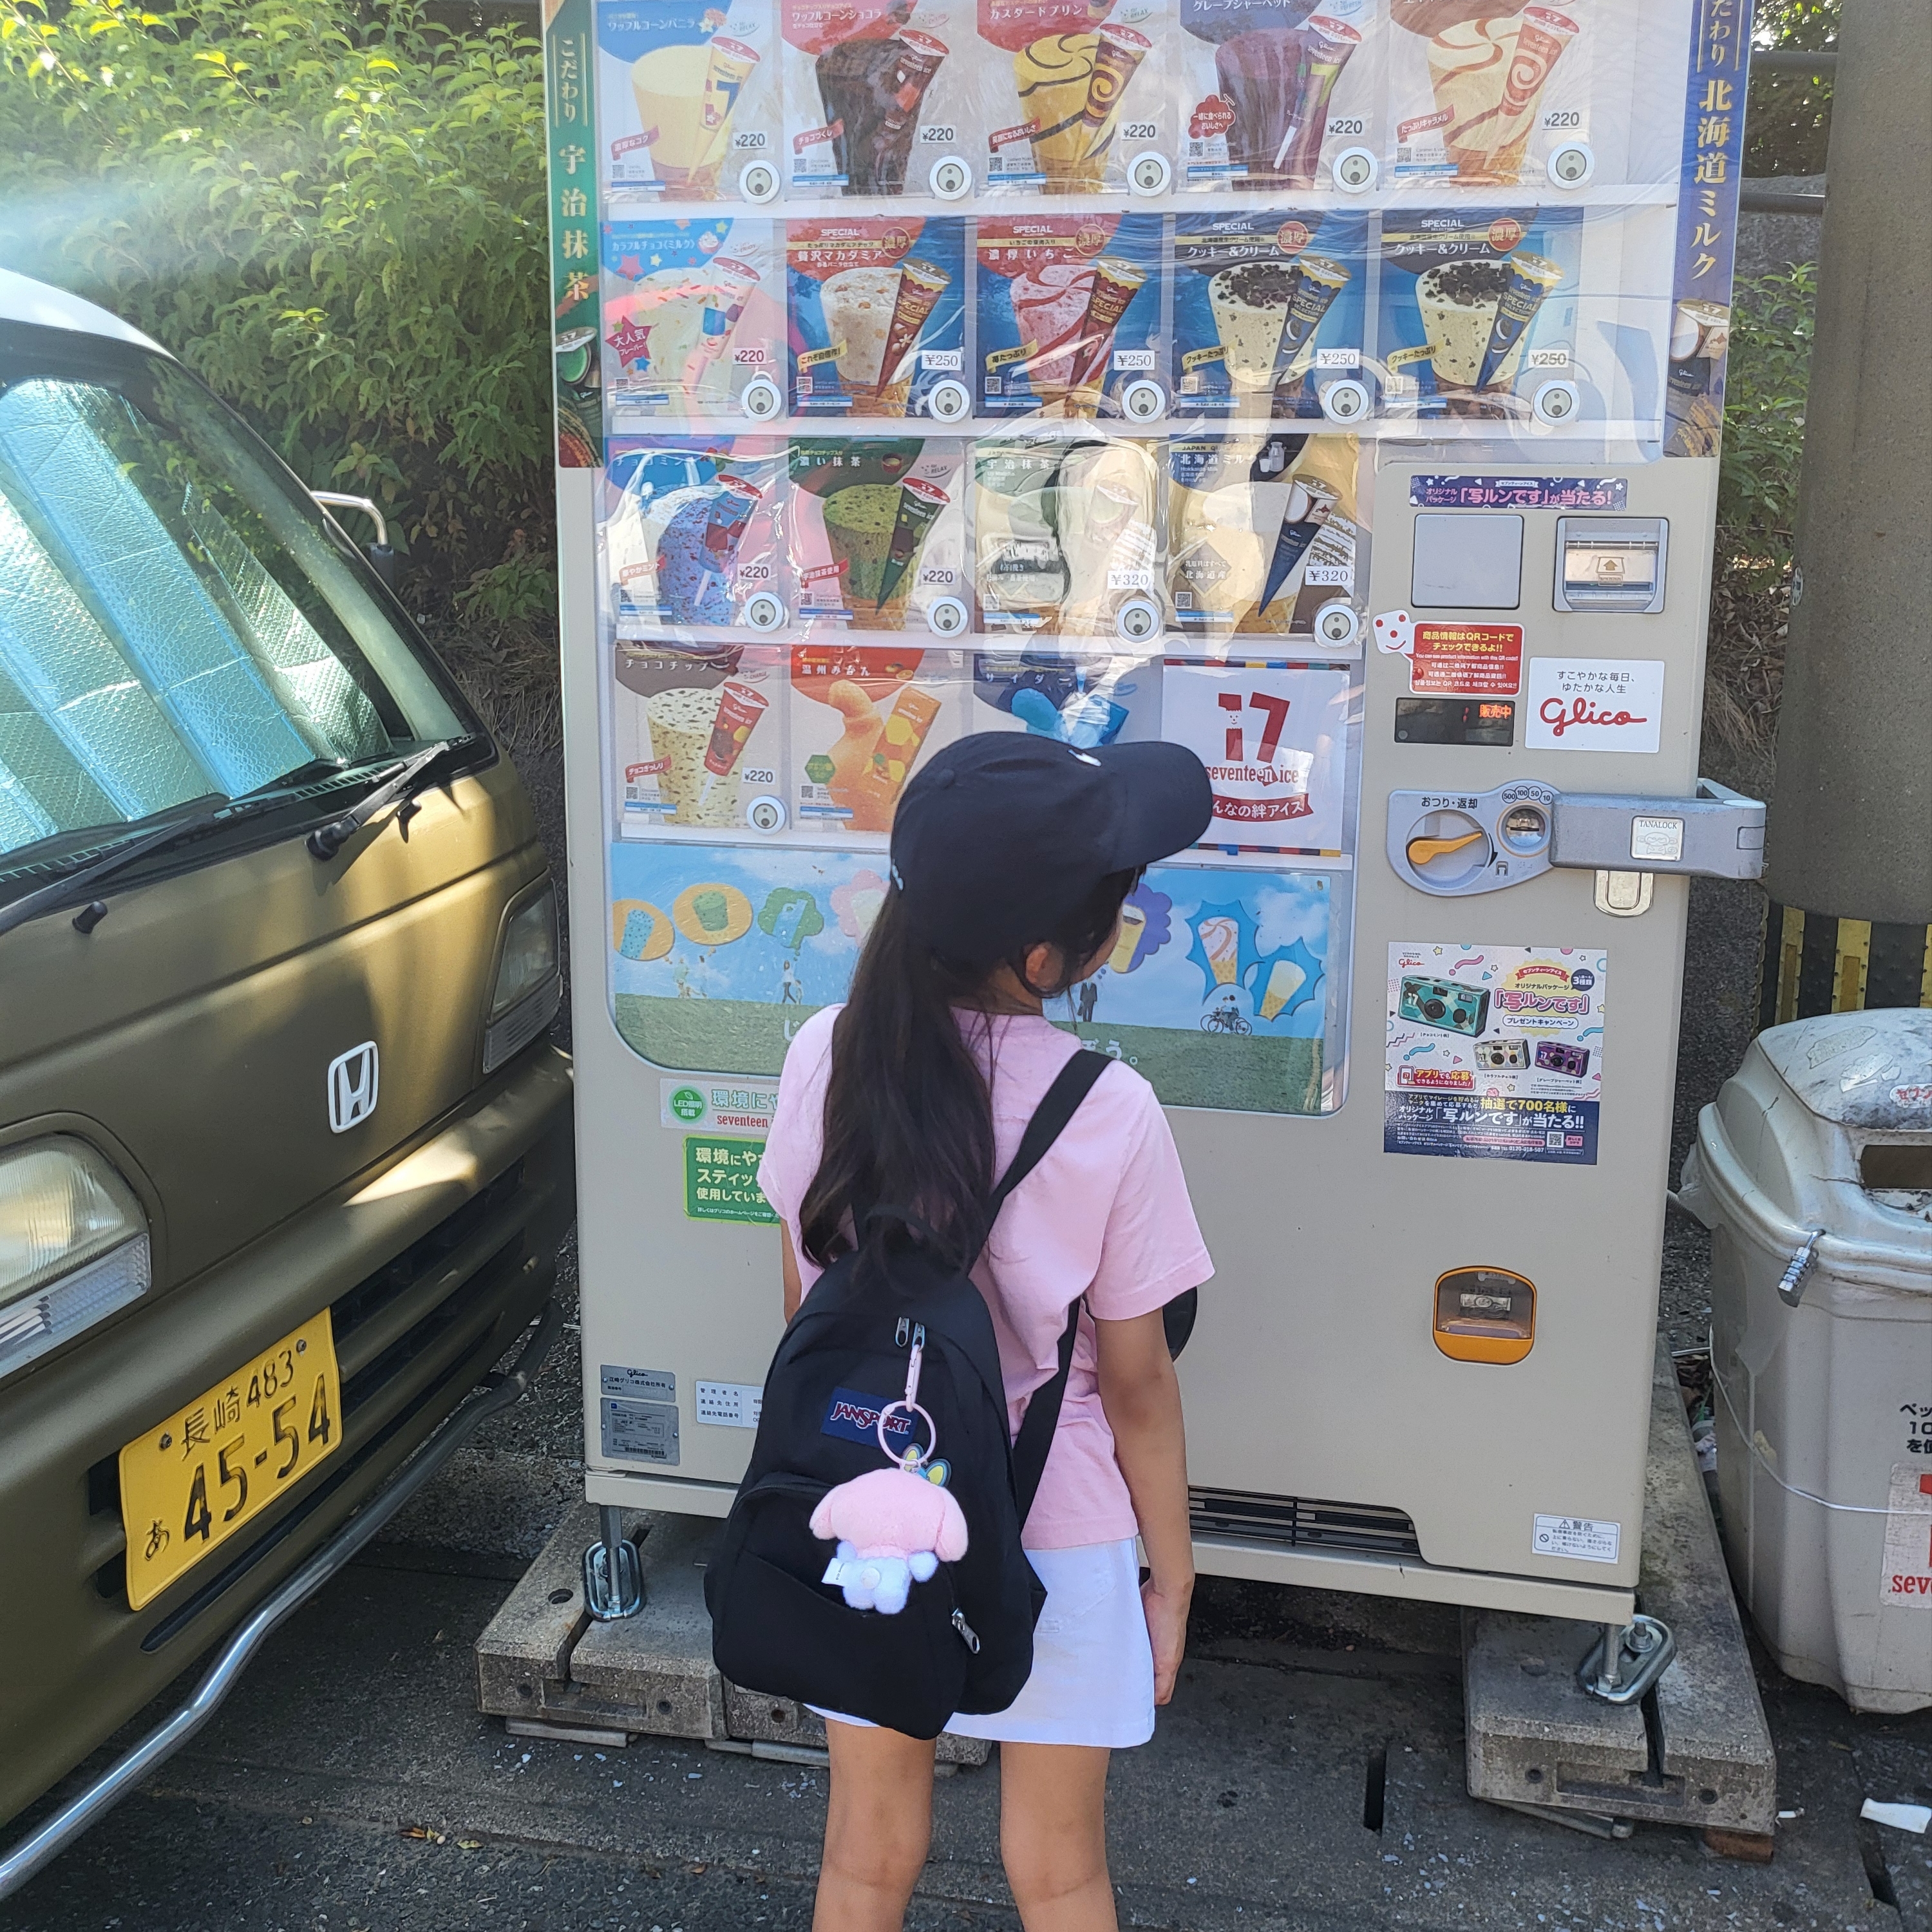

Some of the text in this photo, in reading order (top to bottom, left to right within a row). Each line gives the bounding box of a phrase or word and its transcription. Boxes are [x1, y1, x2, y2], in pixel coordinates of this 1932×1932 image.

[791, 9, 883, 21] ワッフルコーンショコラ
[990, 5, 1083, 20] カスタードプリン
[607, 19, 696, 33] ワッフルコーンバニラ
[1401, 113, 1448, 134] たっぷりキャラメル
[1544, 111, 1580, 128] ¥220
[1123, 124, 1156, 138] ¥220
[1201, 122, 1224, 131] おいしさへ
[1329, 120, 1363, 134] ¥220
[735, 133, 766, 147] ¥220
[798, 129, 833, 146] チョコづくし
[922, 128, 954, 142] ¥220
[614, 135, 649, 153] 濃厚なコク
[558, 39, 590, 301] こだわり 宇治抹茶
[1690, 78, 1734, 281] 北海道ミルク
[1012, 225, 1054, 234] SPECIAL
[1212, 222, 1255, 231] SPECIAL
[1421, 219, 1464, 228] SPECIAL
[820, 228, 860, 237] SPECIAL
[1280, 231, 1305, 244] 濃厚
[1491, 227, 1519, 242] 濃厚
[797, 250, 883, 262] 贅沢マカダミア
[988, 248, 1075, 261] 濃厚いちご
[1187, 245, 1280, 258] クッキー&クリーム
[1394, 243, 1490, 256] クッキー&クリーム
[1092, 295, 1124, 314] SPECIAL
[1292, 294, 1326, 313] SPECIAL
[1502, 292, 1537, 312] SPECIAL
[614, 328, 646, 348] 大人気
[735, 350, 764, 363] ¥220
[925, 355, 959, 366] ¥250
[1117, 355, 1152, 366] ¥250
[1186, 346, 1229, 365] クッキーたっぷり
[1321, 353, 1356, 365] ¥250
[1392, 346, 1436, 363] クッキーたっぷり
[1531, 353, 1567, 365] ¥250
[799, 456, 862, 468] 濃い抹茶
[931, 466, 948, 474] RELAX
[1425, 488, 1458, 496] オリジナル
[1425, 495, 1457, 504] パッケージ
[739, 565, 769, 579] ¥220
[923, 570, 953, 583] ¥220
[1184, 570, 1227, 580] 北海道産
[1309, 570, 1349, 582] ¥320
[1111, 574, 1149, 585] ¥320
[1422, 631, 1515, 642] 商品情報はQRコードで
[1432, 643, 1503, 653] チェックできるよ!!
[625, 659, 709, 672] チョコチップ
[1557, 670, 1636, 683] すこやかな毎日、
[1562, 683, 1627, 694] ゆたかな人生
[1540, 697, 1647, 737] Glico
[628, 762, 664, 775] チョコぎっしり
[1205, 764, 1300, 783] seventeen ice
[744, 770, 773, 783] ¥220
[1504, 792, 1516, 800] 500
[1421, 797, 1478, 810] おつり・返却
[1639, 820, 1678, 830] TANALOCK
[1398, 958, 1425, 968] Glico
[1522, 967, 1562, 976] セブンティーンアイス
[1495, 990, 1589, 1014] 「写ルンです」
[1506, 1018, 1575, 1027] プレゼントキャンペーン
[1416, 1070, 1470, 1081] アプリでも応募
[674, 1100, 703, 1109] LED照明
[1398, 1106, 1434, 1114] オリジナル
[1481, 1097, 1577, 1113] 抽選で700名様に
[717, 1115, 768, 1128] seventeen
[696, 1187, 767, 1204] 使用していま
[627, 1368, 649, 1378] Glico
[700, 1388, 739, 1397] 管理者名
[180, 1350, 294, 1461] 長崎 483
[700, 1399, 739, 1408] 連絡先住所
[700, 1410, 739, 1419] 連絡先電話番号
[144, 1372, 330, 1562] あ 45-54
[1572, 1520, 1594, 1532] 警告
[1891, 1575, 1932, 1595] sev
